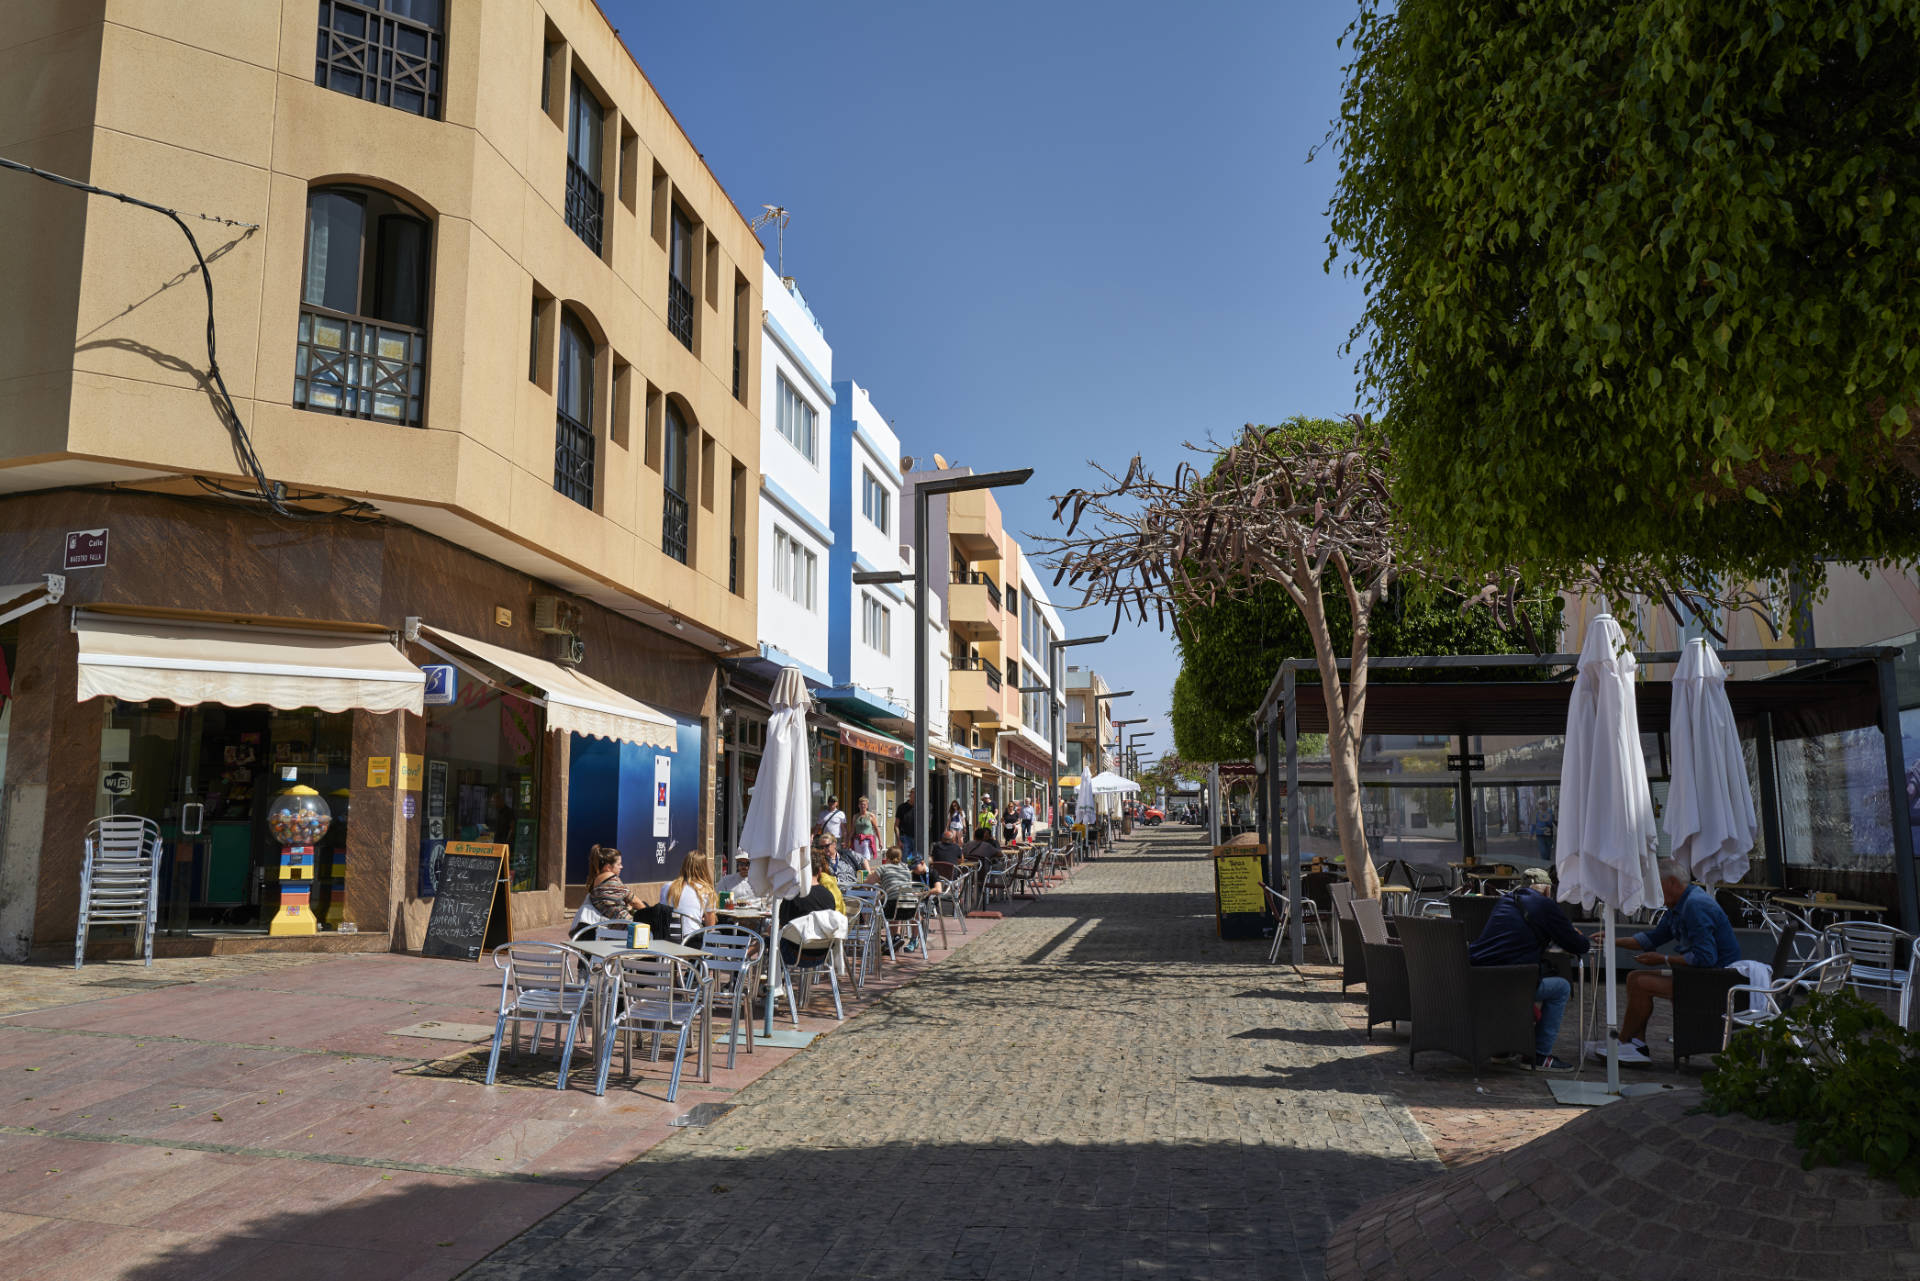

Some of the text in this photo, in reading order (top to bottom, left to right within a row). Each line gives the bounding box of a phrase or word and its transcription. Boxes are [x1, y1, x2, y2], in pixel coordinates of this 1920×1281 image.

[88, 539, 103, 547] Calle
[70, 553, 102, 563] MAESTRO FALLA
[465, 844, 494, 855] Tropical
